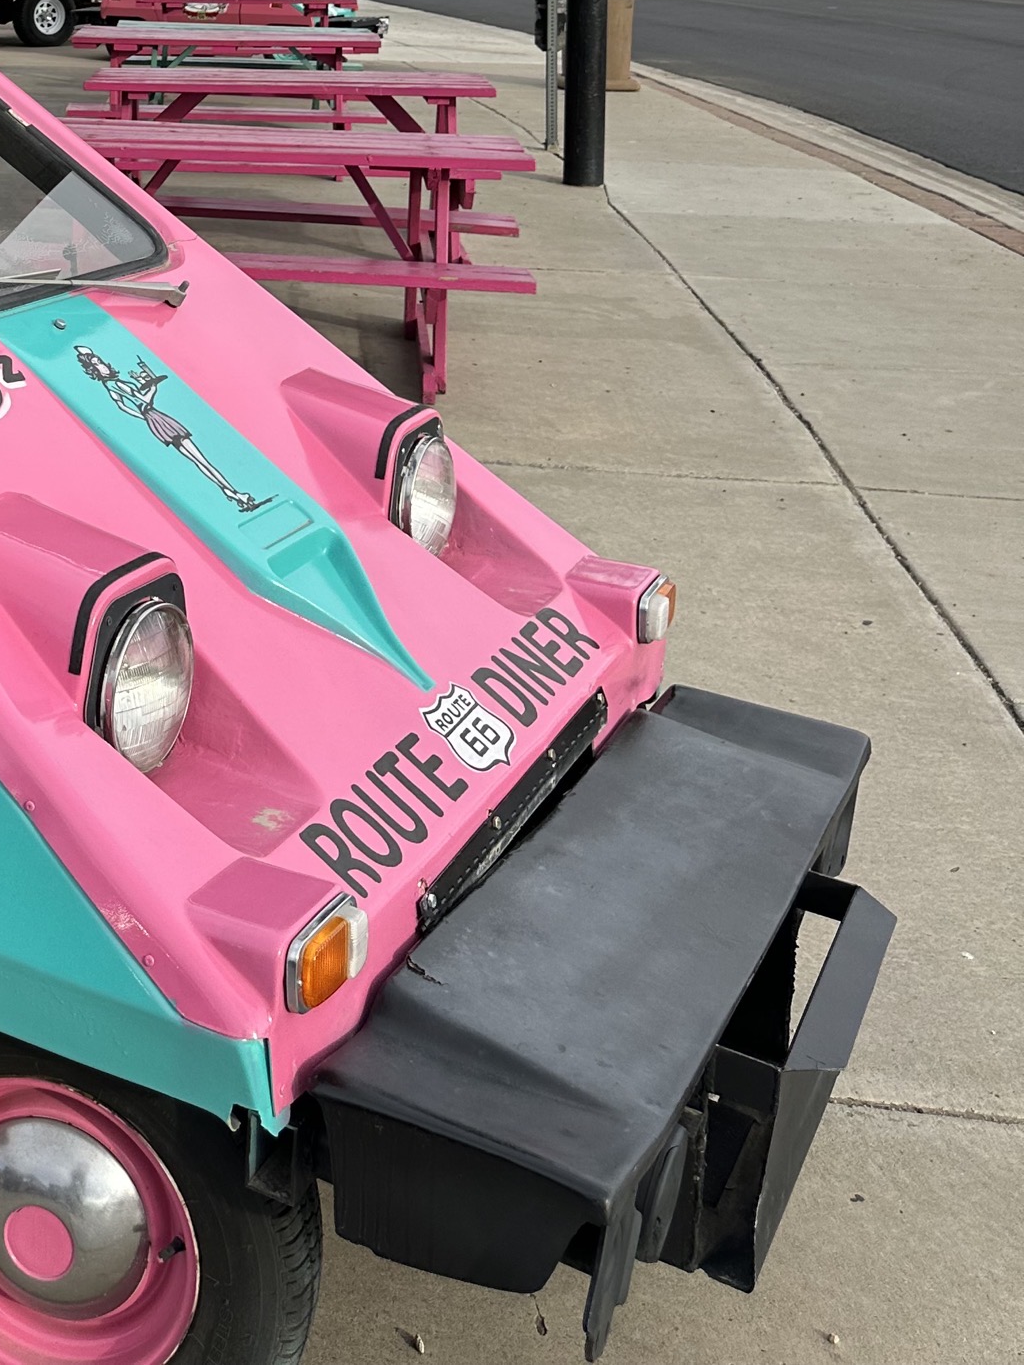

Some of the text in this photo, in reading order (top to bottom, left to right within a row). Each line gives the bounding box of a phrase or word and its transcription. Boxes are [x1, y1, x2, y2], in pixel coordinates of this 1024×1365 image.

[299, 608, 600, 898] ROUTE 66 DINER
[435, 694, 471, 731] ROUTE
